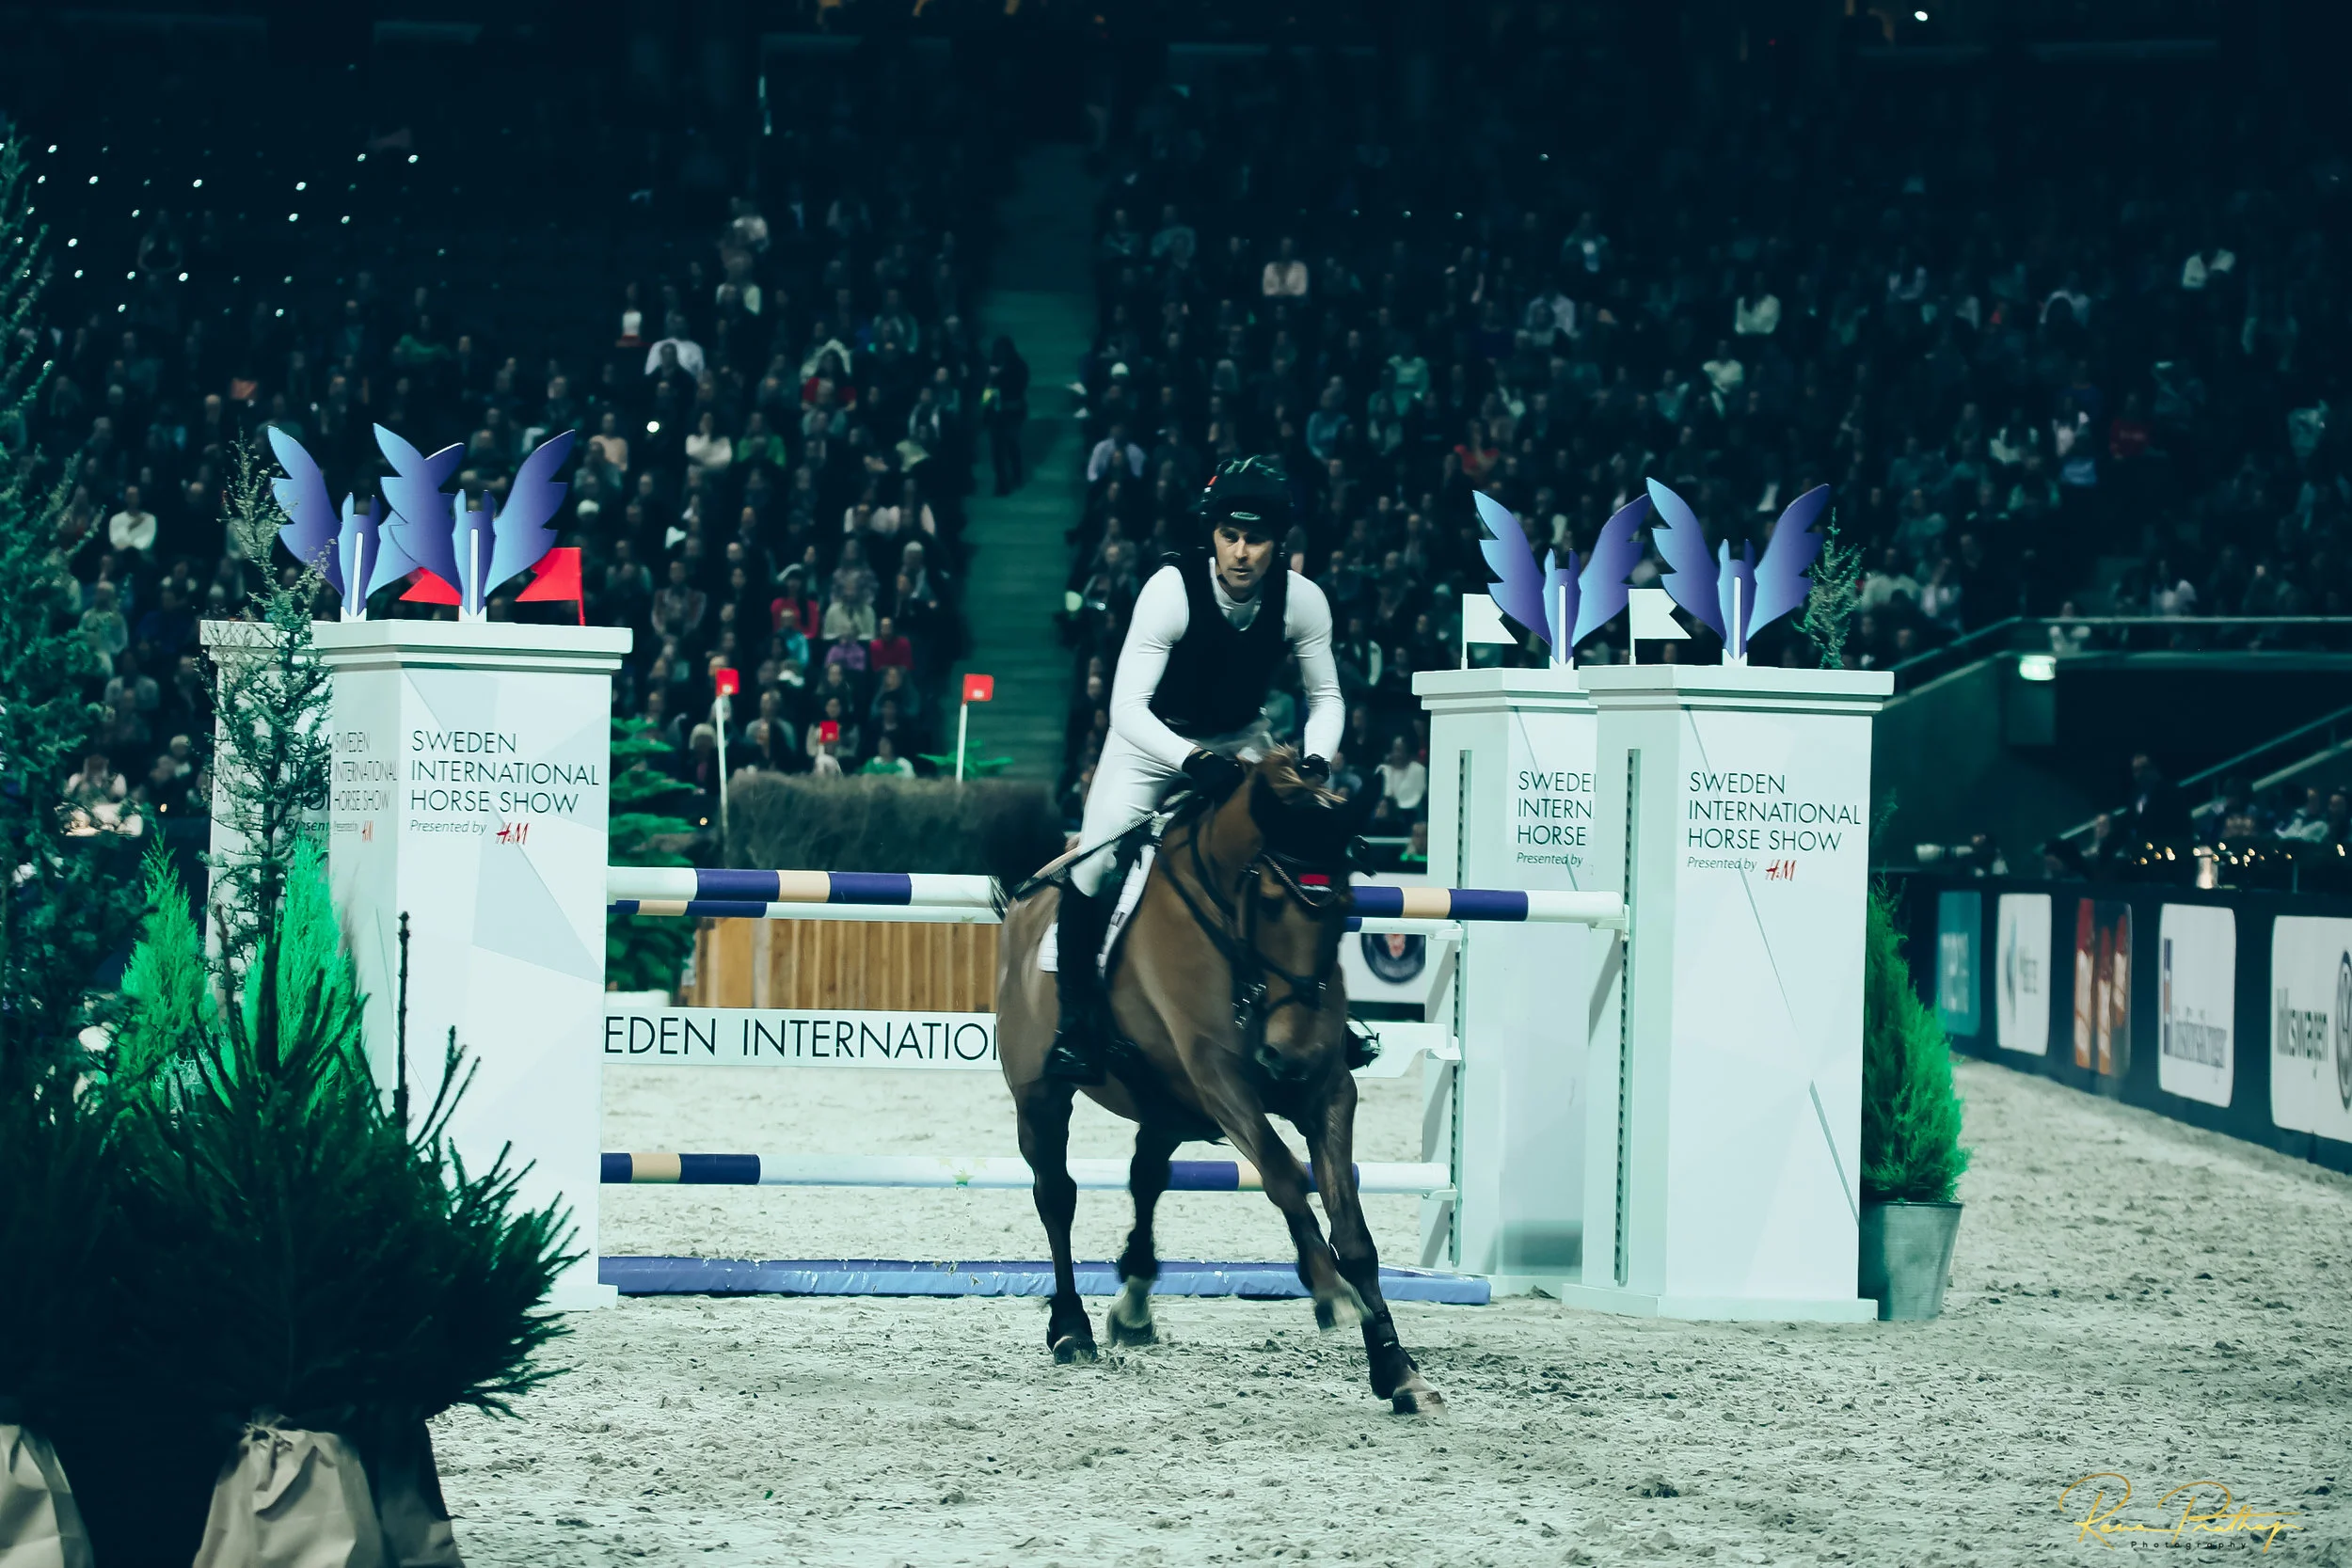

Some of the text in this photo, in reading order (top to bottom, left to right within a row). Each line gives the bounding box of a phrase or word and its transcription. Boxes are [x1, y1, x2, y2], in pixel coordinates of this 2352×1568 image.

[335, 731, 371, 752] SWEDEN
[411, 729, 516, 754] SWEDEN
[411, 759, 600, 786] INTERNATIONAL
[1518, 770, 1597, 793] SWEDE
[1689, 771, 1787, 795] SWEDEN
[410, 789, 580, 815] HORSE SHOW
[1518, 798, 1597, 820] INTERN
[1689, 800, 1862, 826] INTERNATIONAL
[409, 819, 470, 832] Presented
[472, 820, 488, 836] by
[1517, 825, 1587, 847] HORSE
[1688, 828, 1842, 852] HORSE SHOW
[1516, 851, 1583, 868] Presented by
[1687, 856, 1742, 869] Presented
[1743, 858, 1757, 873] by
[742, 1019, 997, 1061] INTERNATIO
